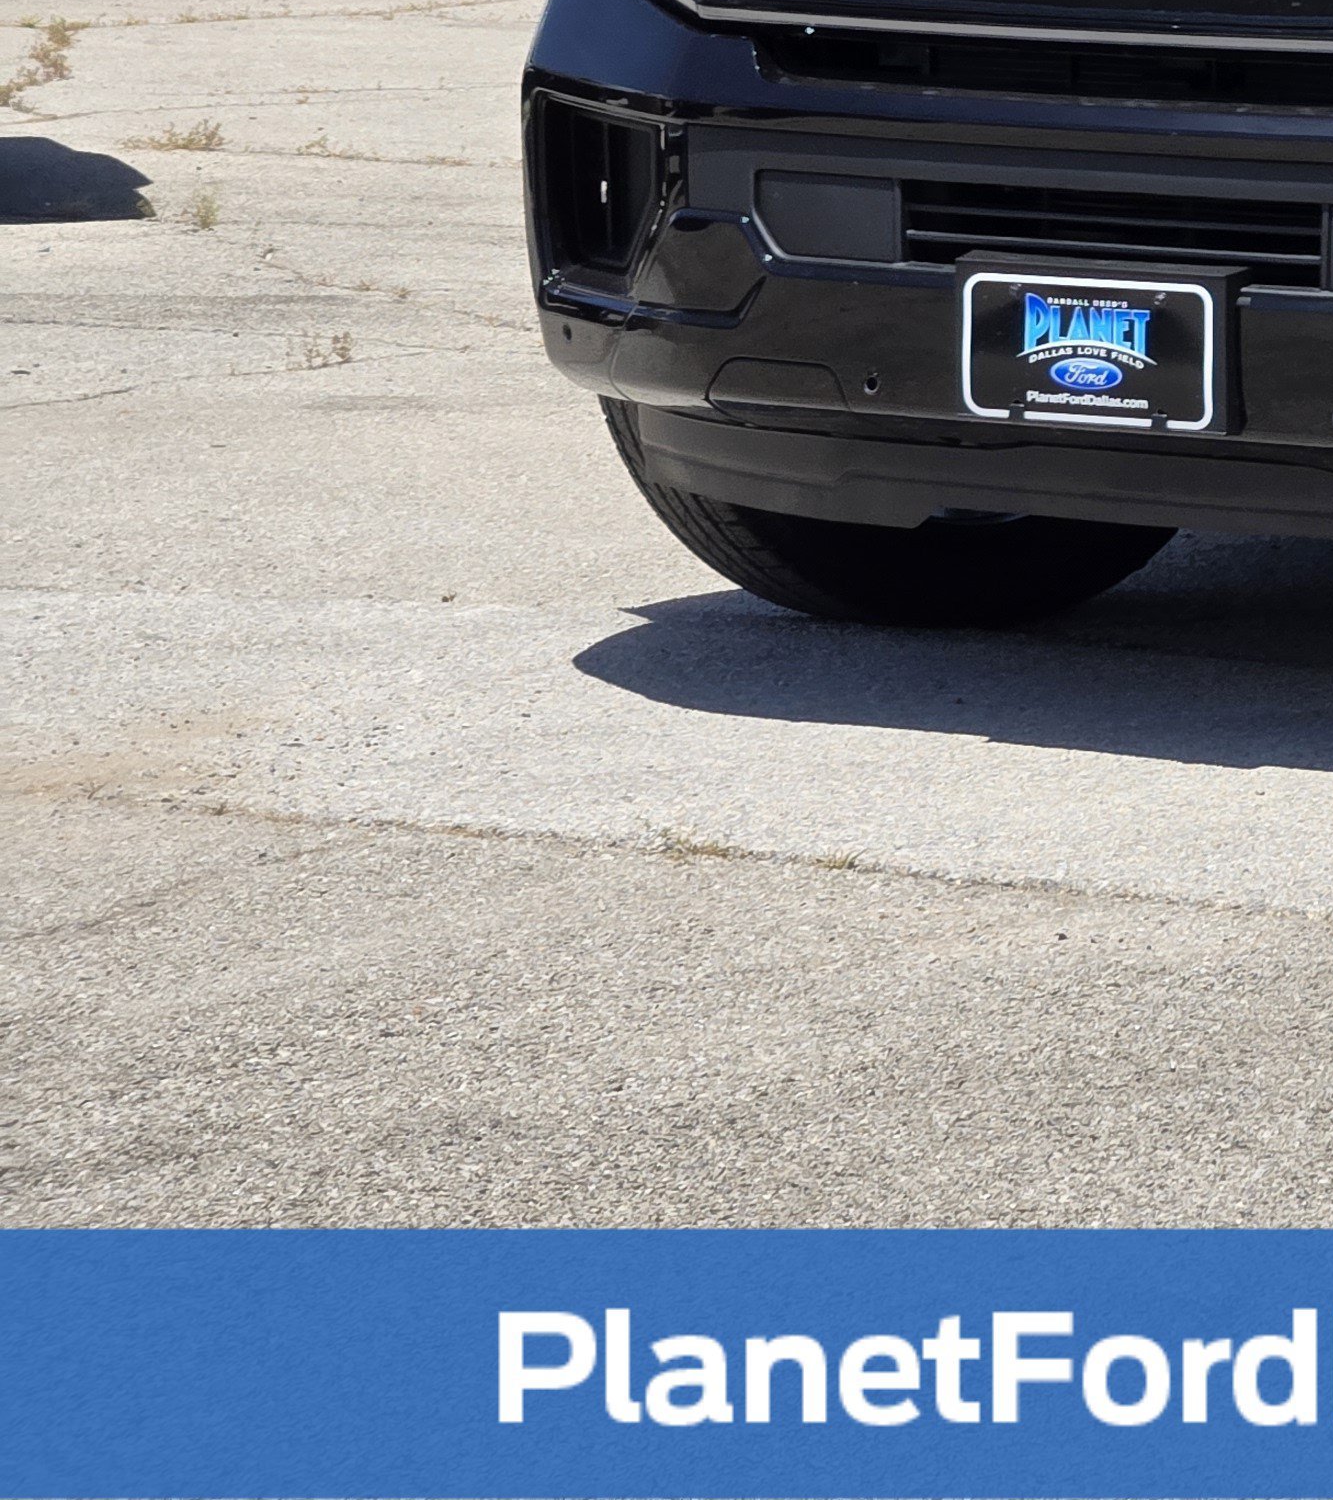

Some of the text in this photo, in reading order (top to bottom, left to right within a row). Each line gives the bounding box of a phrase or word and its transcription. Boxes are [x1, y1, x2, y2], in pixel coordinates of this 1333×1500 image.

[1024, 292, 1151, 357] PLANET
[1028, 346, 1145, 370] DALLAS LOVE FIELD
[1063, 363, 1109, 386] Ford
[1025, 389, 1150, 410] PlanetFordDallas.com
